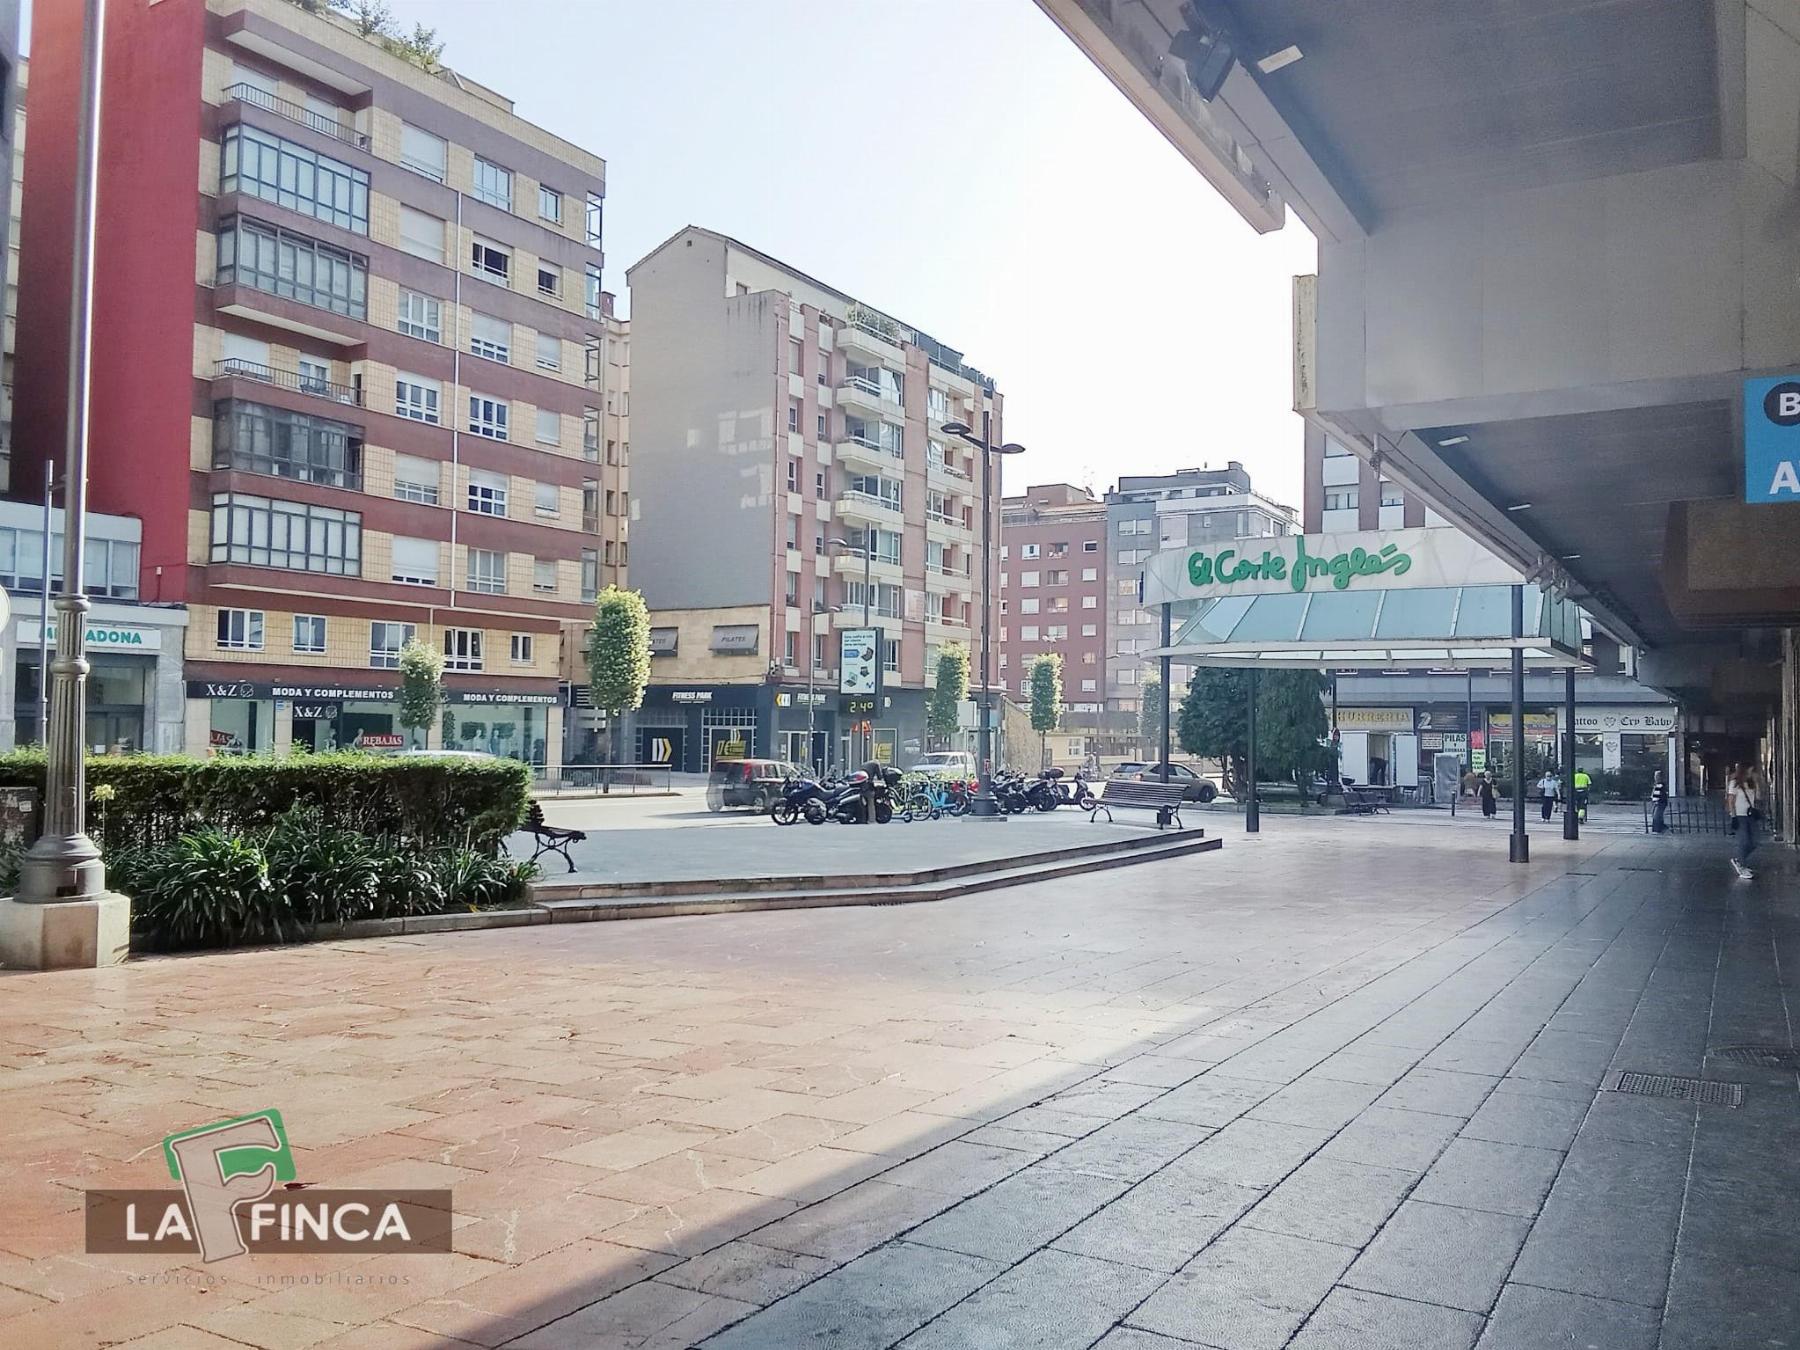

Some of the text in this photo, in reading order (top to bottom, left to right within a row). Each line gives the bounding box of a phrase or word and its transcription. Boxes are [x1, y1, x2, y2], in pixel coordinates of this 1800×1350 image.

[1769, 461, 1800, 495] A
[1188, 535, 1412, 593] El Corte Inglés
[206, 684, 237, 697] X&Z
[272, 687, 393, 699] MODA Y COMPLEMENTOS
[672, 692, 712, 700] FITNESS PARK
[463, 693, 557, 704] MODA Y COMPLEMENTOS
[294, 706, 323, 718] X&Z
[1575, 716, 1598, 726] attoo
[1620, 716, 1672, 727] Cry Baby
[363, 736, 402, 745] REBAJAS
[1444, 734, 1466, 742] PILAS
